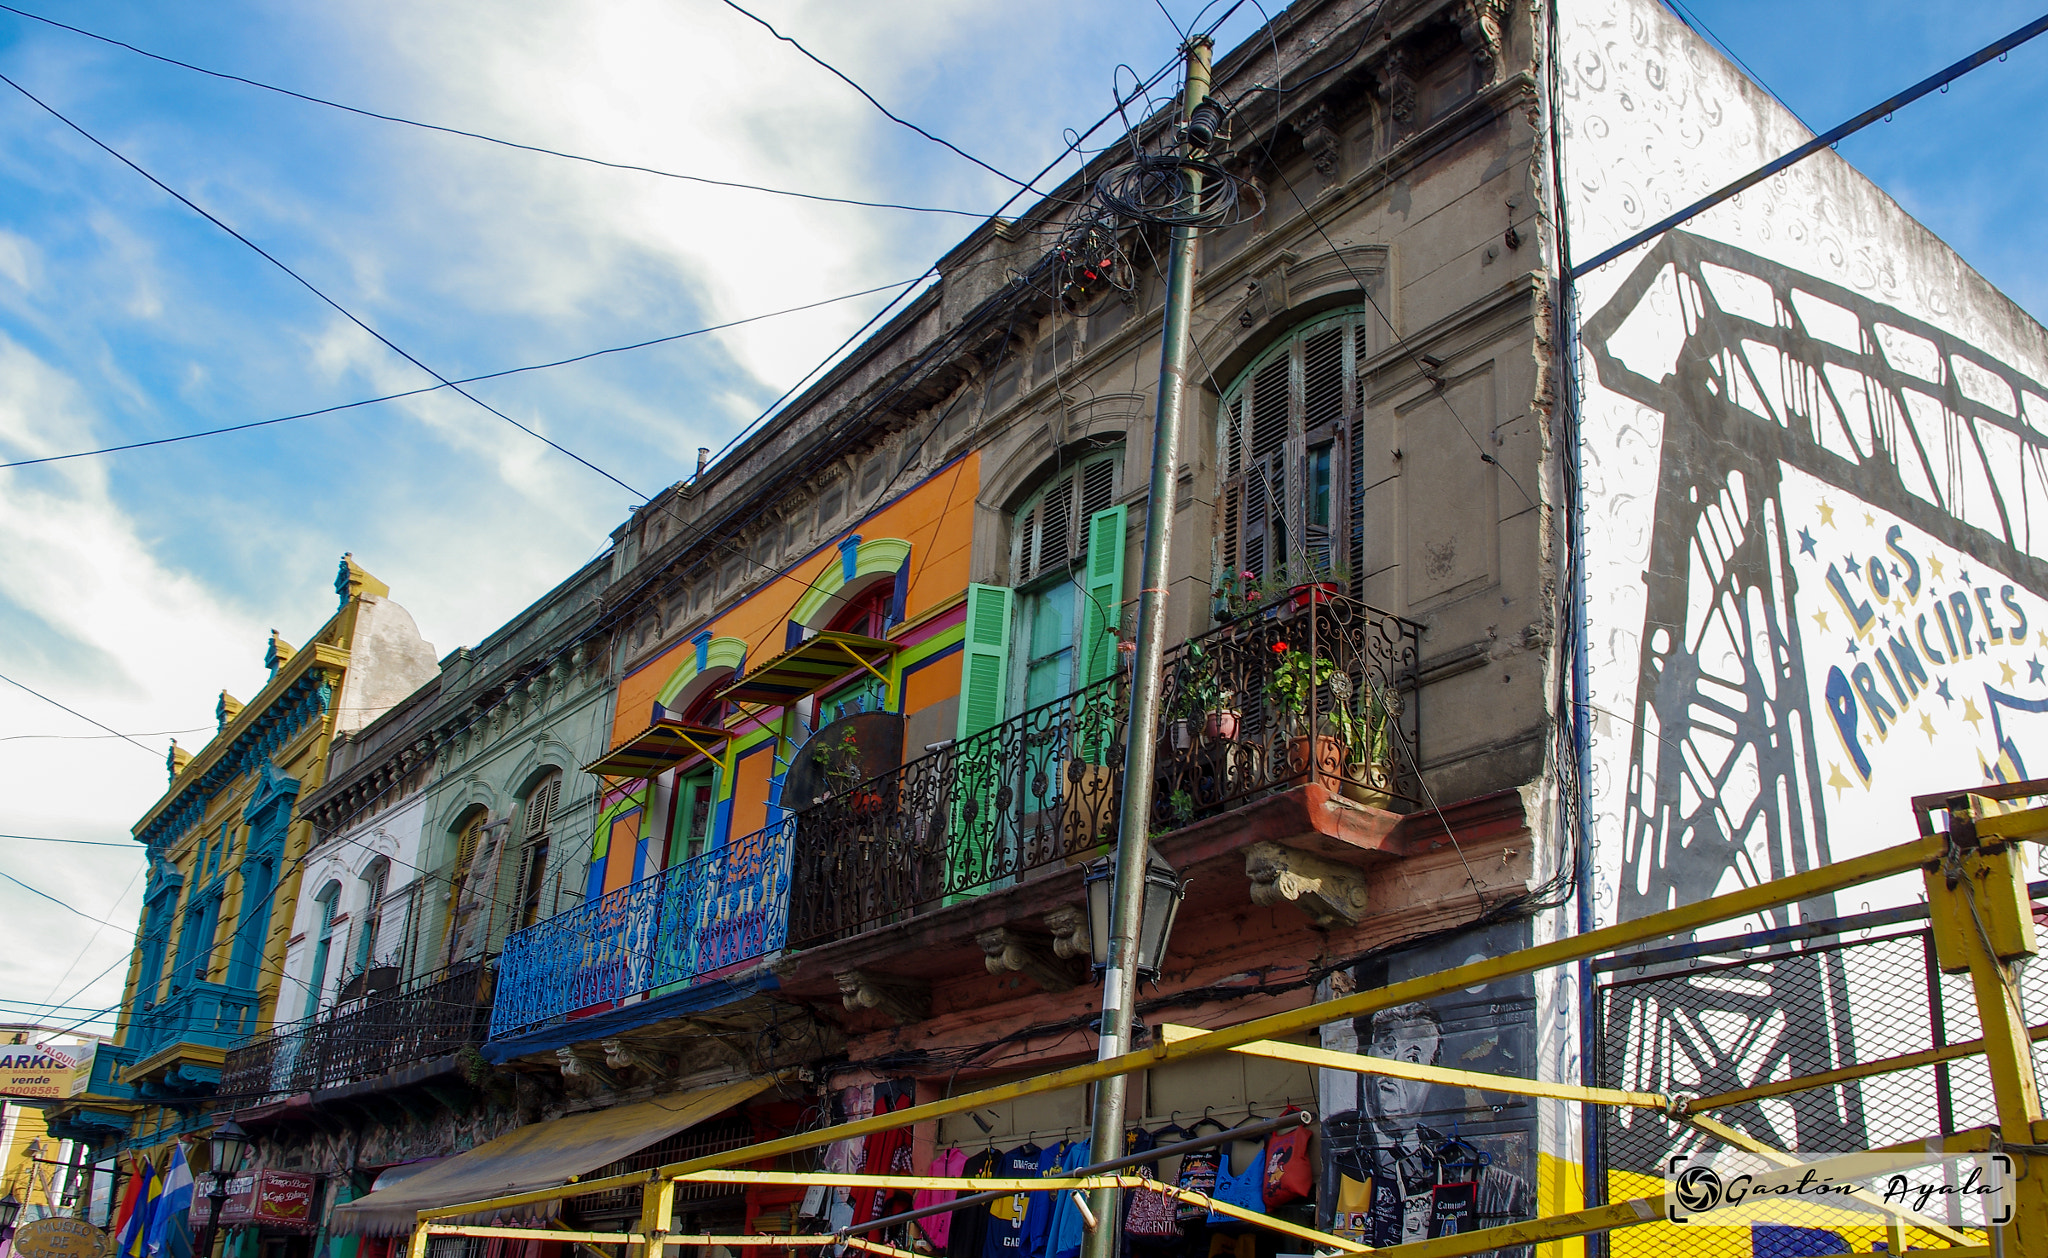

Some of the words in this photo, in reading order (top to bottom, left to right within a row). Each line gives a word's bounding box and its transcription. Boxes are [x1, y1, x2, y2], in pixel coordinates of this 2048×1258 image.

[1825, 524, 1921, 642] LOS
[11, 1076, 50, 1084] vende
[0, 1086, 60, 1095] 43008585
[267, 1175, 291, 1188] Tango
[292, 1179, 311, 1189] Bar
[37, 1221, 91, 1238] MUSEO
[49, 1235, 70, 1248] DE
